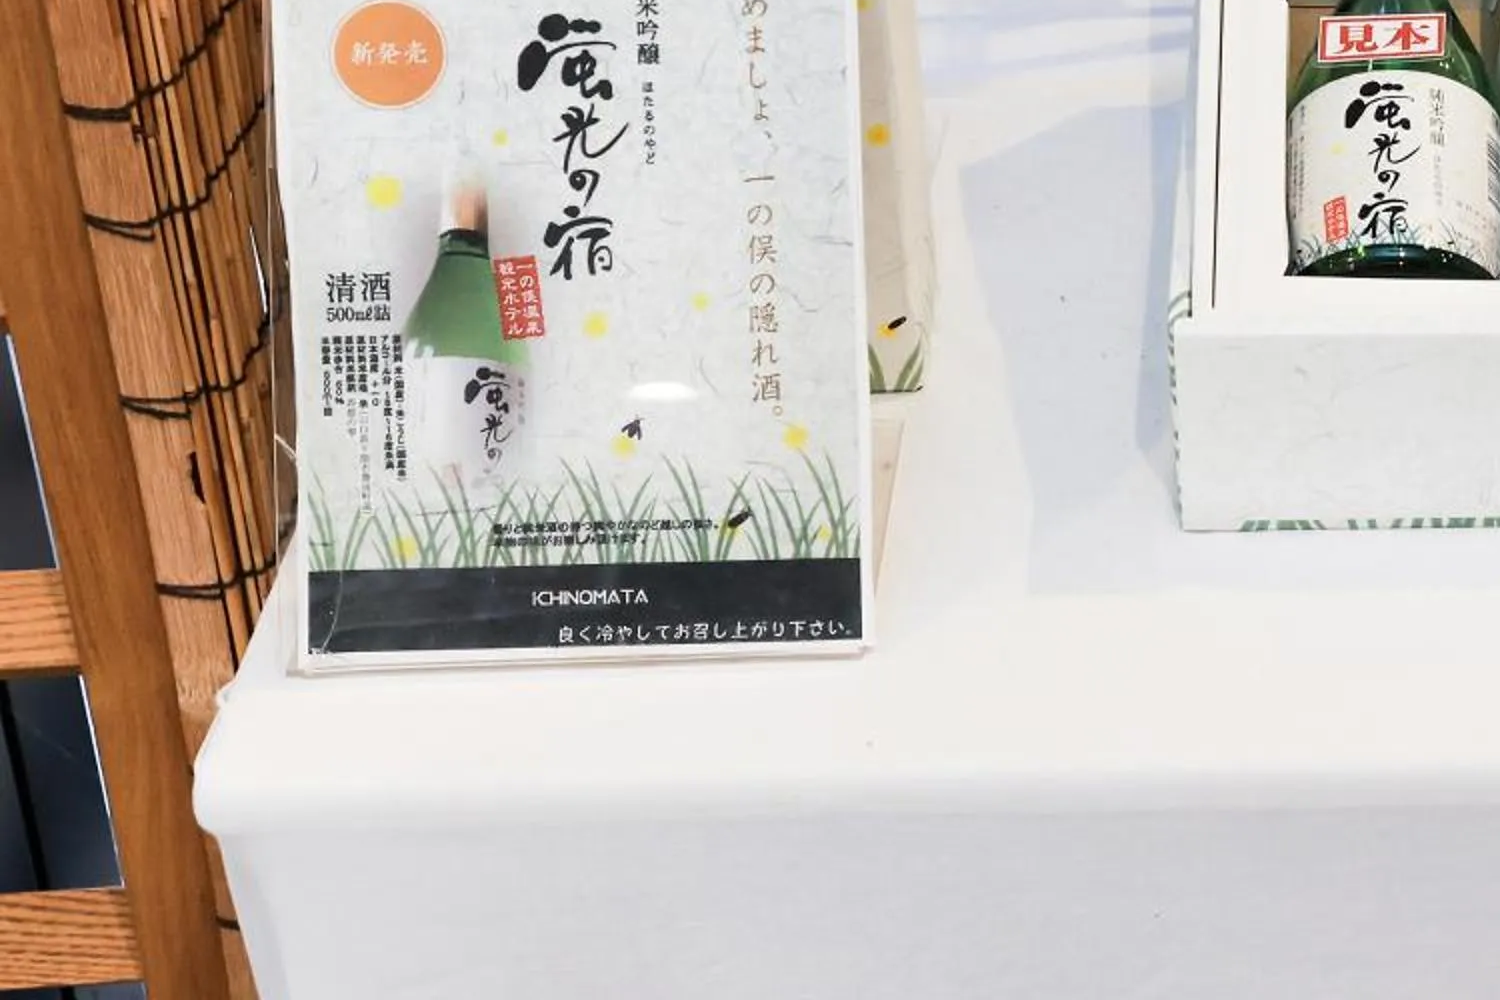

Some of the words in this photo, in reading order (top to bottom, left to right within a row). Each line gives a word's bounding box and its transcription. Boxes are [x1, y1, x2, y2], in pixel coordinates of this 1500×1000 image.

[1337, 23, 1430, 54] 見本
[350, 39, 428, 67] 新発売
[325, 271, 391, 303] 清酒
[531, 589, 649, 607] ICHINOMATA
[558, 618, 852, 644] 良く冷やしてお召し上がり下さい。
